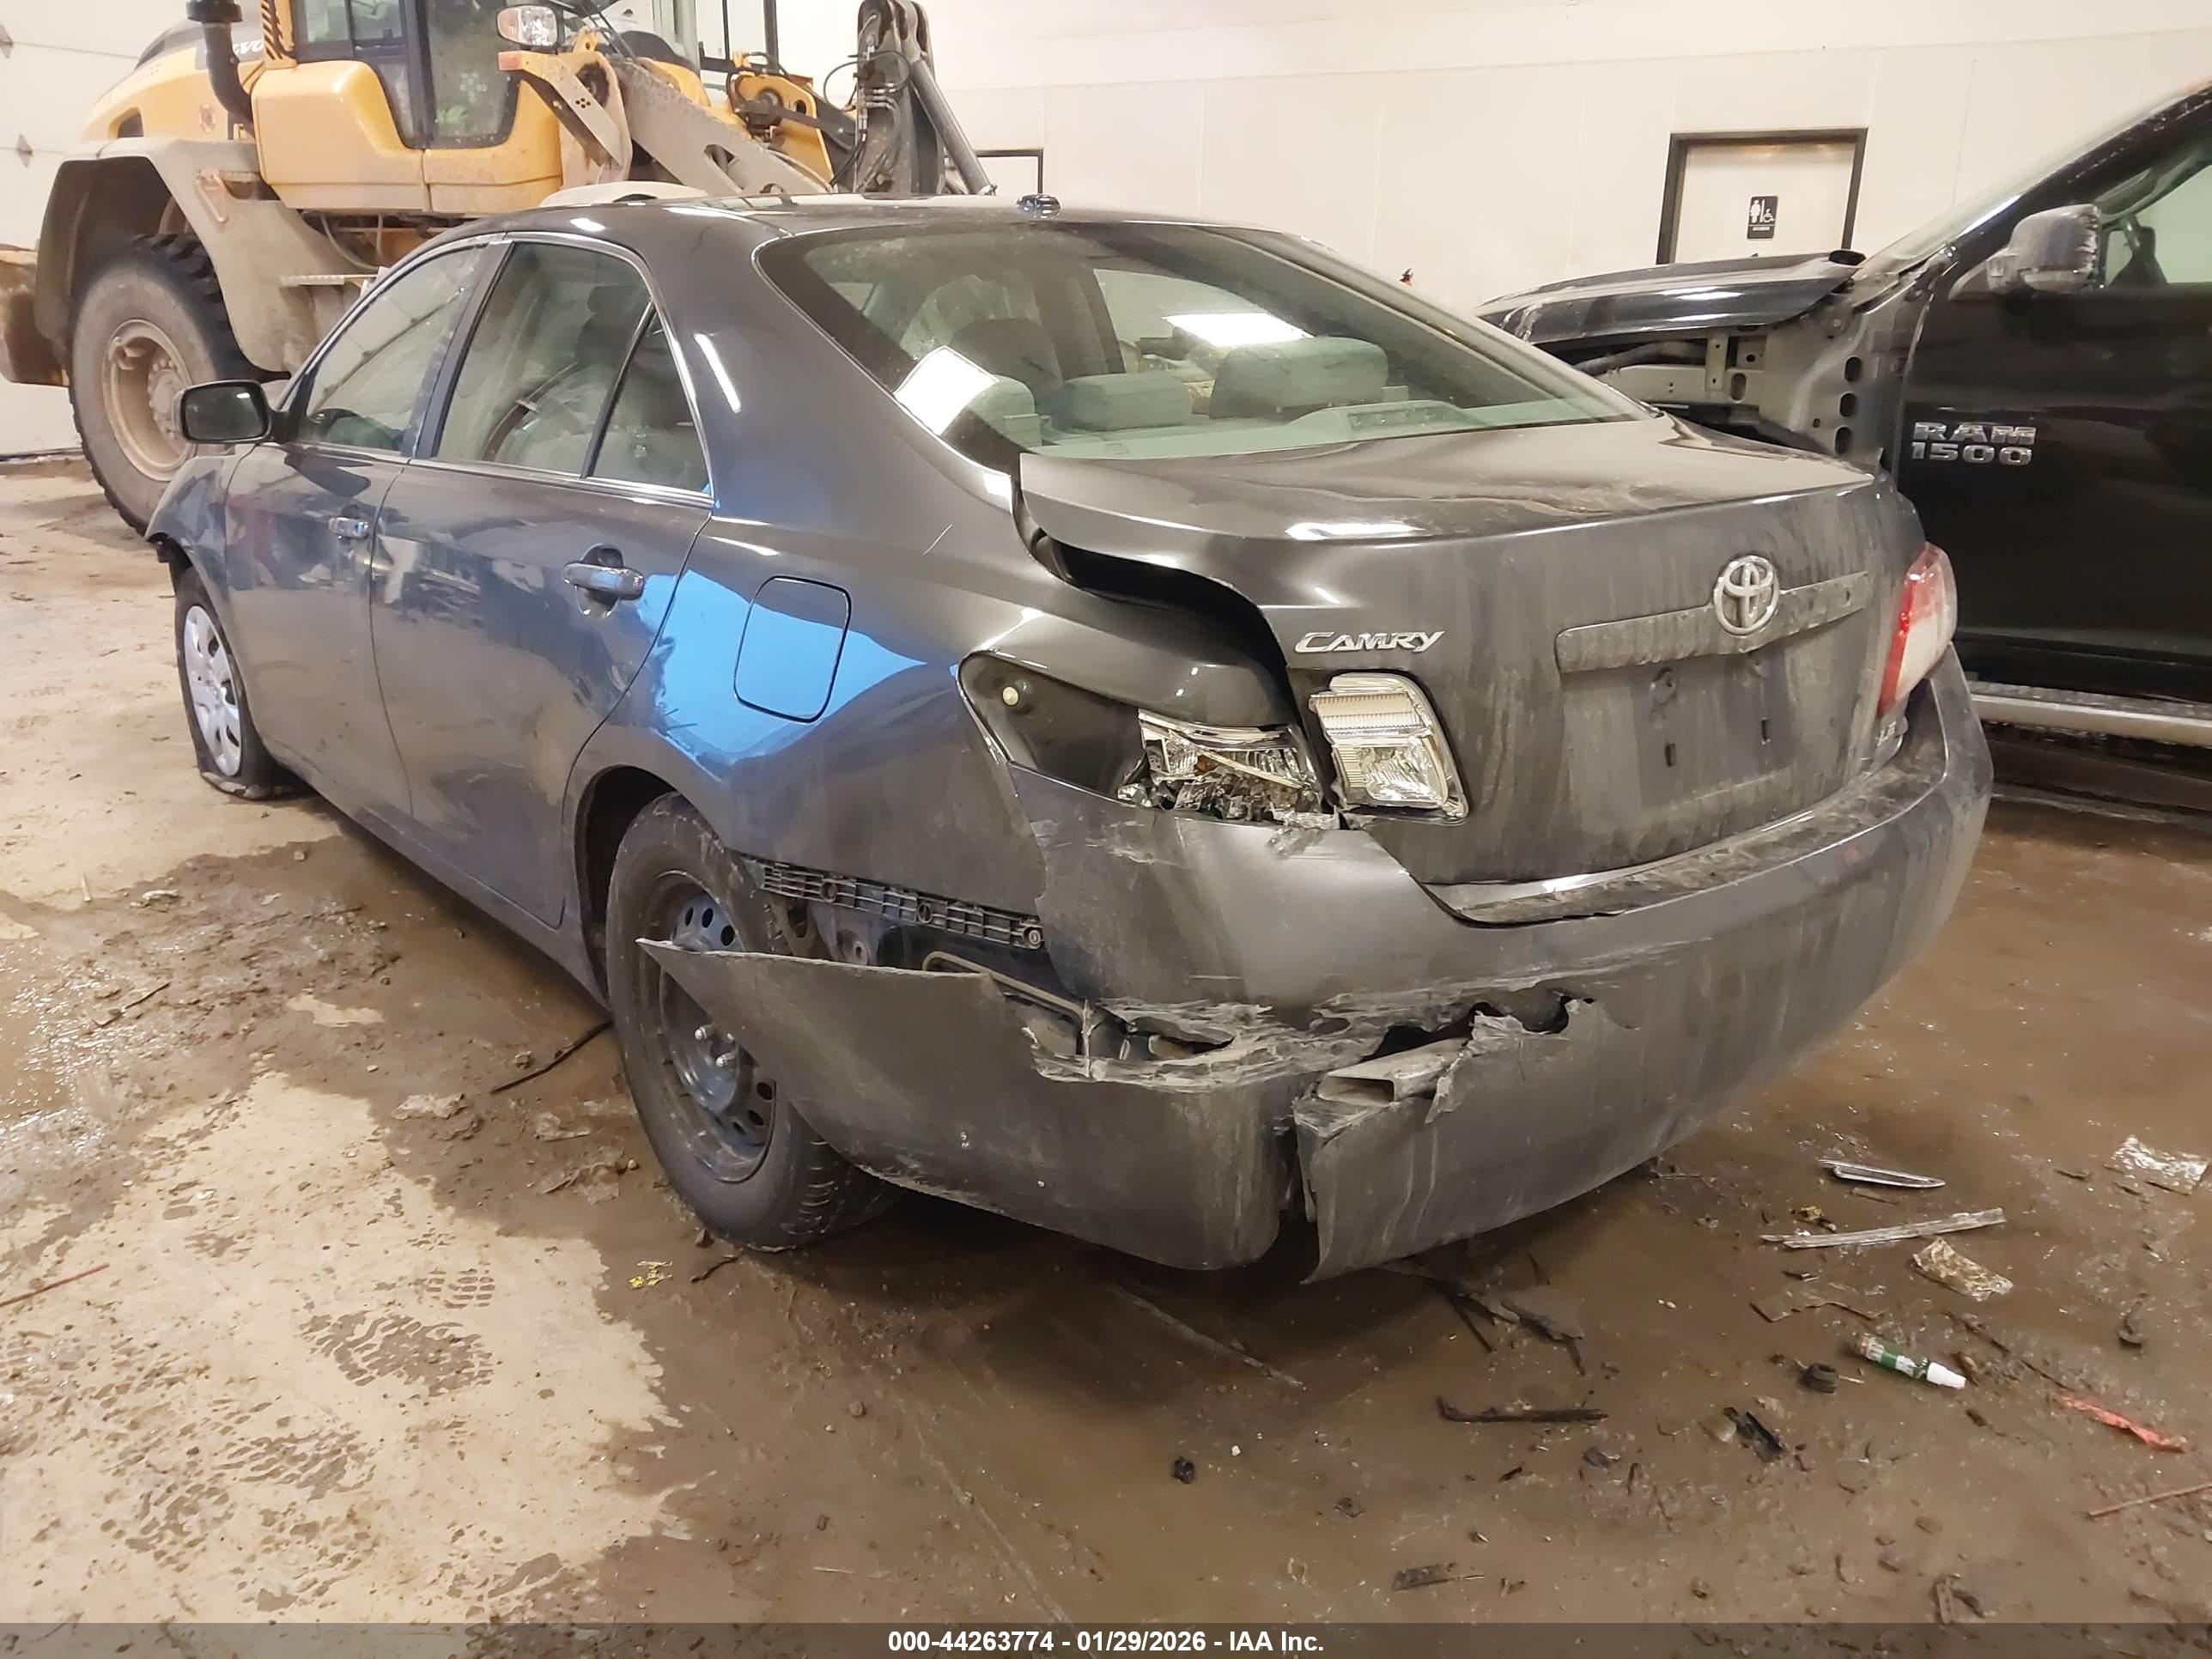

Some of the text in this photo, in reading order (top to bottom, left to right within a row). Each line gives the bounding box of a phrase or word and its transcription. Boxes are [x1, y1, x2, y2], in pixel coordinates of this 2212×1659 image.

[1913, 422, 2037, 445] RAM
[1911, 441, 2033, 465] 1500
[1294, 631, 1445, 653] CAMRY
